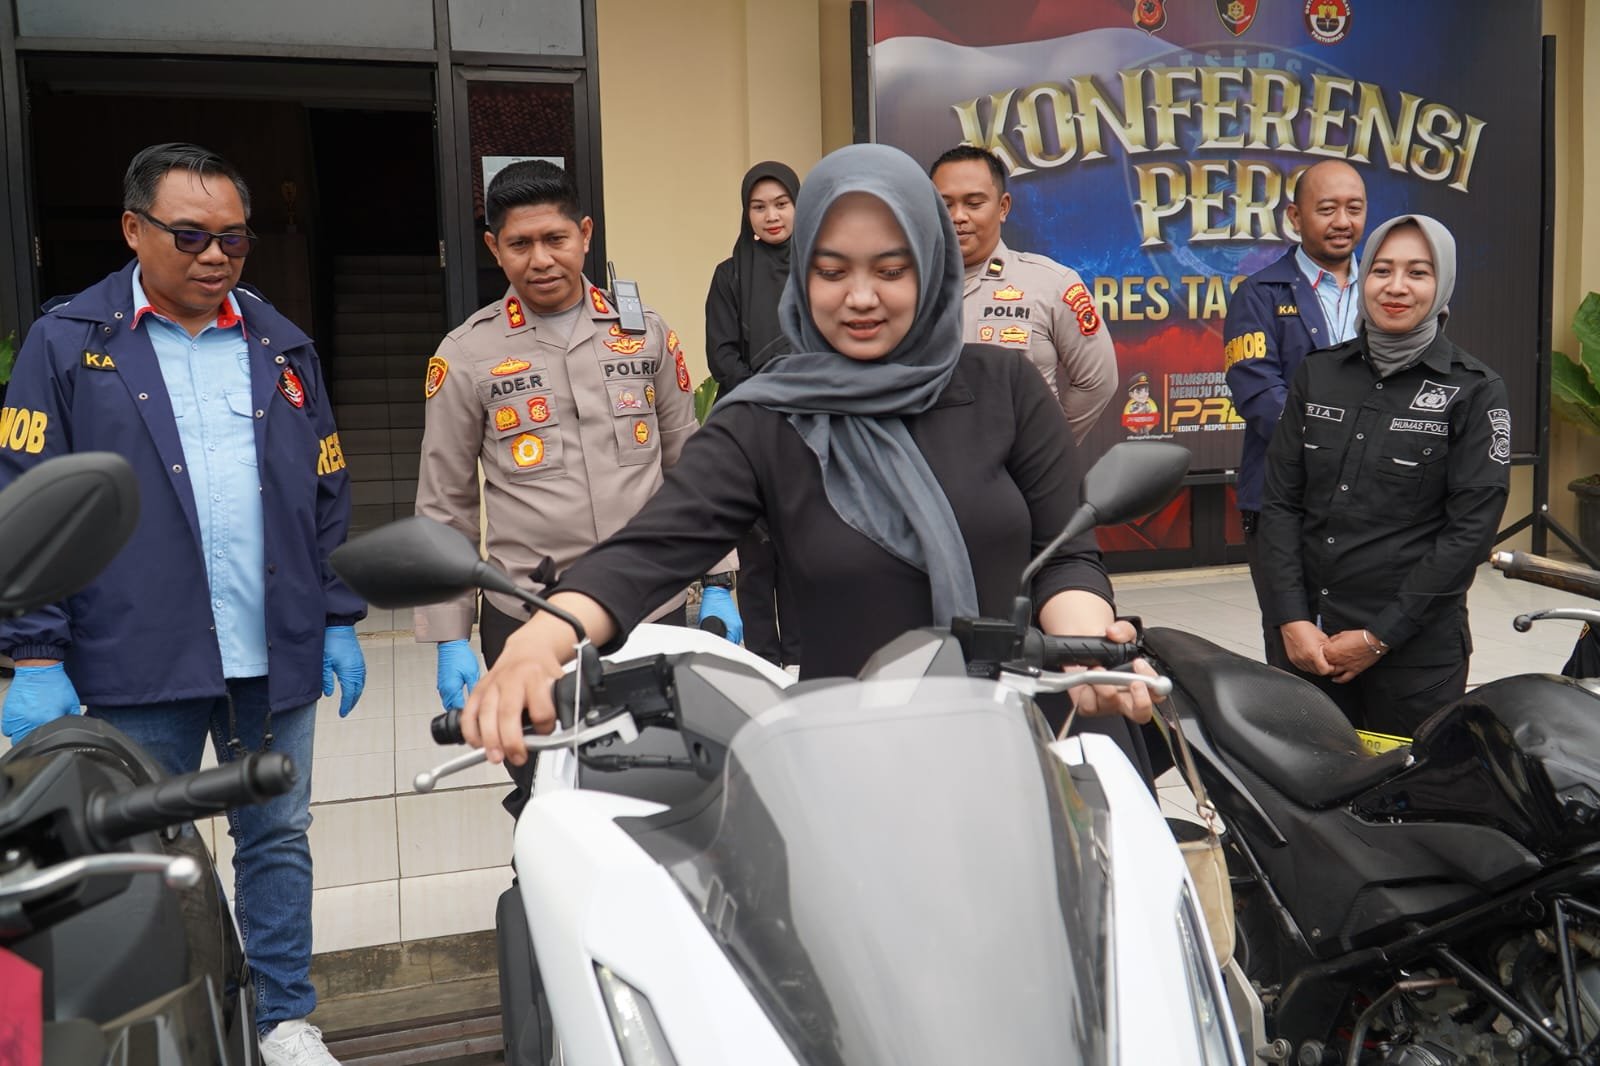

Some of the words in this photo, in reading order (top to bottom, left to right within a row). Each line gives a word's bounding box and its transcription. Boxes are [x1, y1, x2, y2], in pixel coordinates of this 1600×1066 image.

[952, 67, 1488, 193] KONFERENSI
[1094, 276, 1170, 321] RES
[1181, 275, 1248, 320] TA
[983, 305, 1031, 320] POLRI
[85, 351, 117, 369] KA
[604, 360, 656, 378] POLRI
[490, 374, 543, 399] ADE.R
[1169, 385, 1212, 400] MENUJU
[1393, 420, 1423, 431] HUMAS
